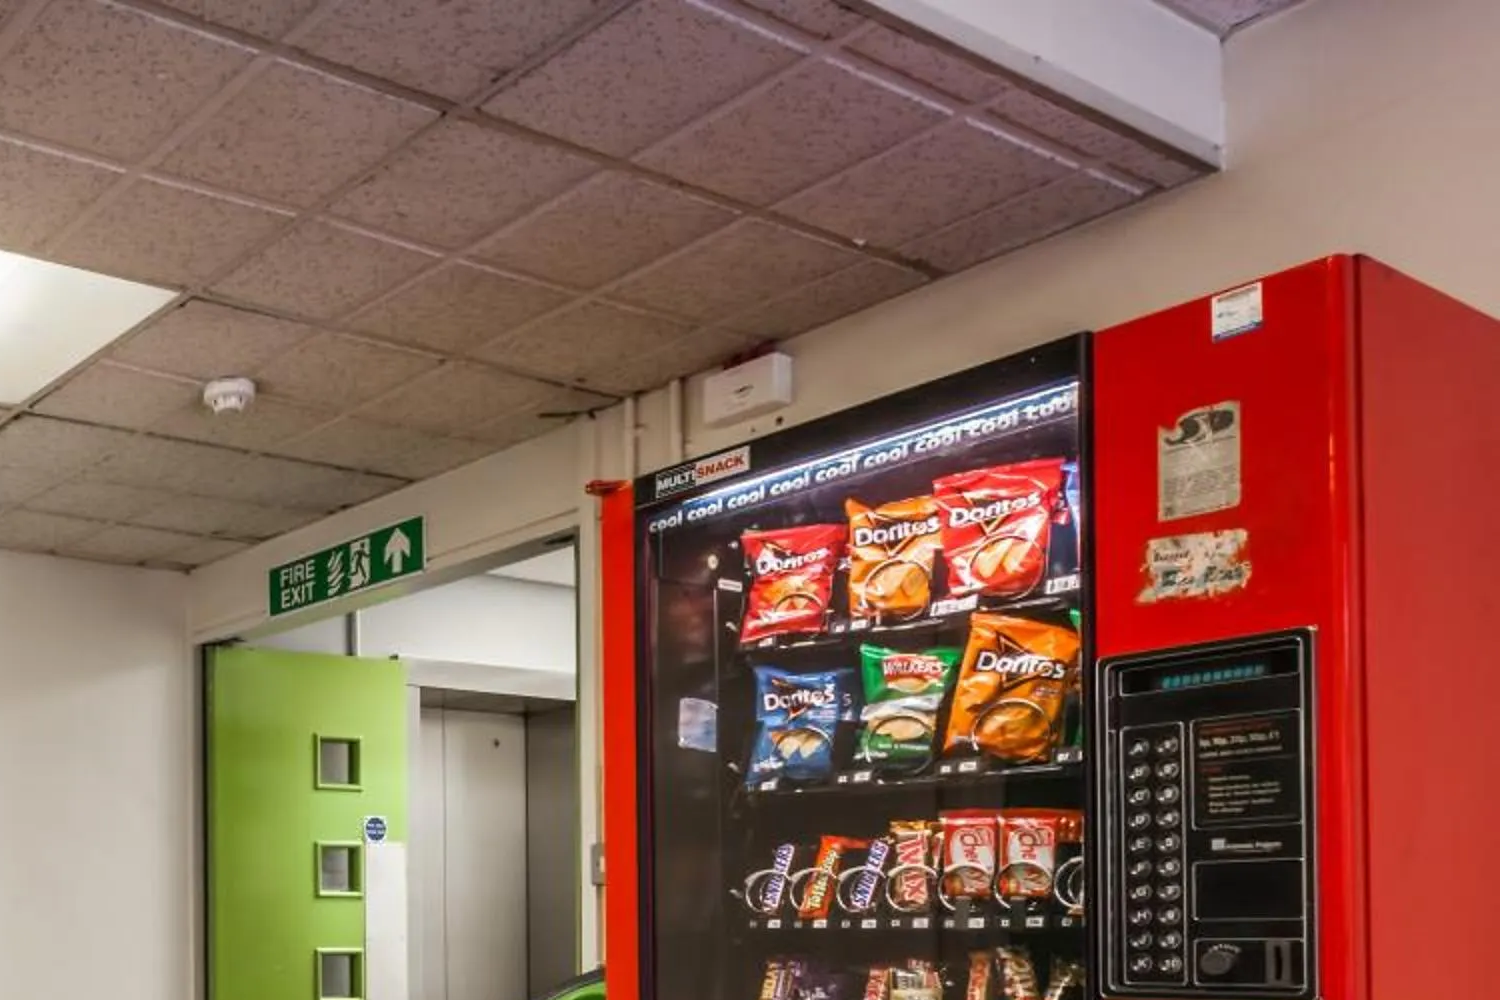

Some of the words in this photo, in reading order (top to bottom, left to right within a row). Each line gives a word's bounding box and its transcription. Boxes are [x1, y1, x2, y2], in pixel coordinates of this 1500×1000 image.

[649, 511, 682, 533] cool
[687, 501, 723, 521] cool
[727, 485, 765, 509] cool
[770, 473, 810, 496] cool
[815, 455, 860, 484] cool
[863, 441, 909, 468] cool
[951, 492, 1040, 527] Doritos
[855, 516, 940, 546] Doritos
[280, 559, 315, 588] FIRE
[756, 547, 831, 575] Doritos
[281, 581, 316, 608] EXIT
[976, 650, 1066, 679] Doritos
[764, 687, 835, 711] Doritos
[763, 844, 795, 907] SNICERS
[852, 840, 889, 908] SNICERS
